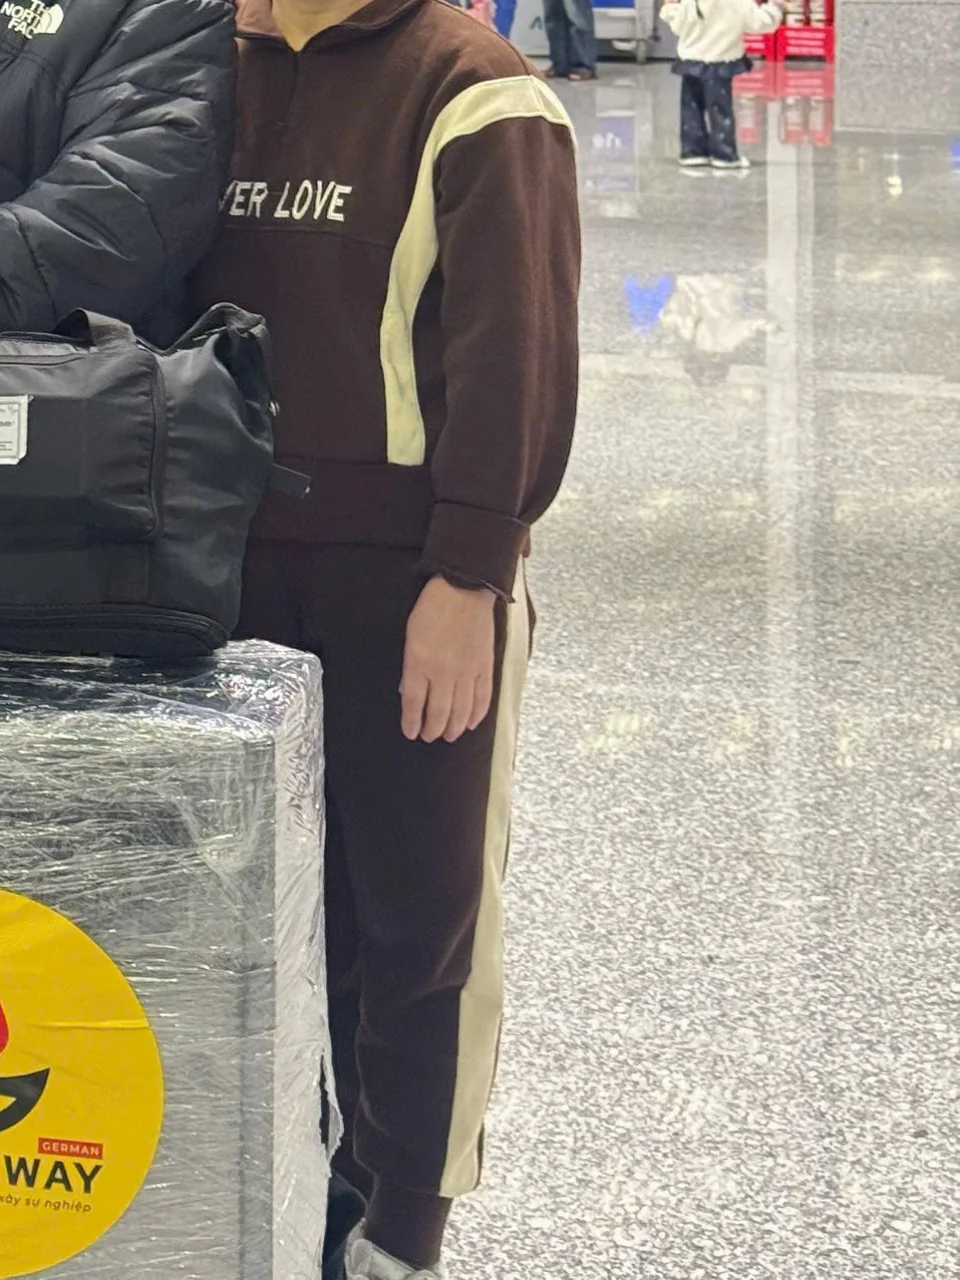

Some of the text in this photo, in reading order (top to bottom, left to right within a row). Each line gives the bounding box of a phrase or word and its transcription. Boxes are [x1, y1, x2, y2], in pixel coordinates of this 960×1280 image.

[0, 1, 42, 28] NORT
[7, 17, 34, 40] FAC
[273, 179, 353, 222] LOVE
[41, 1141, 100, 1157] GERMAN
